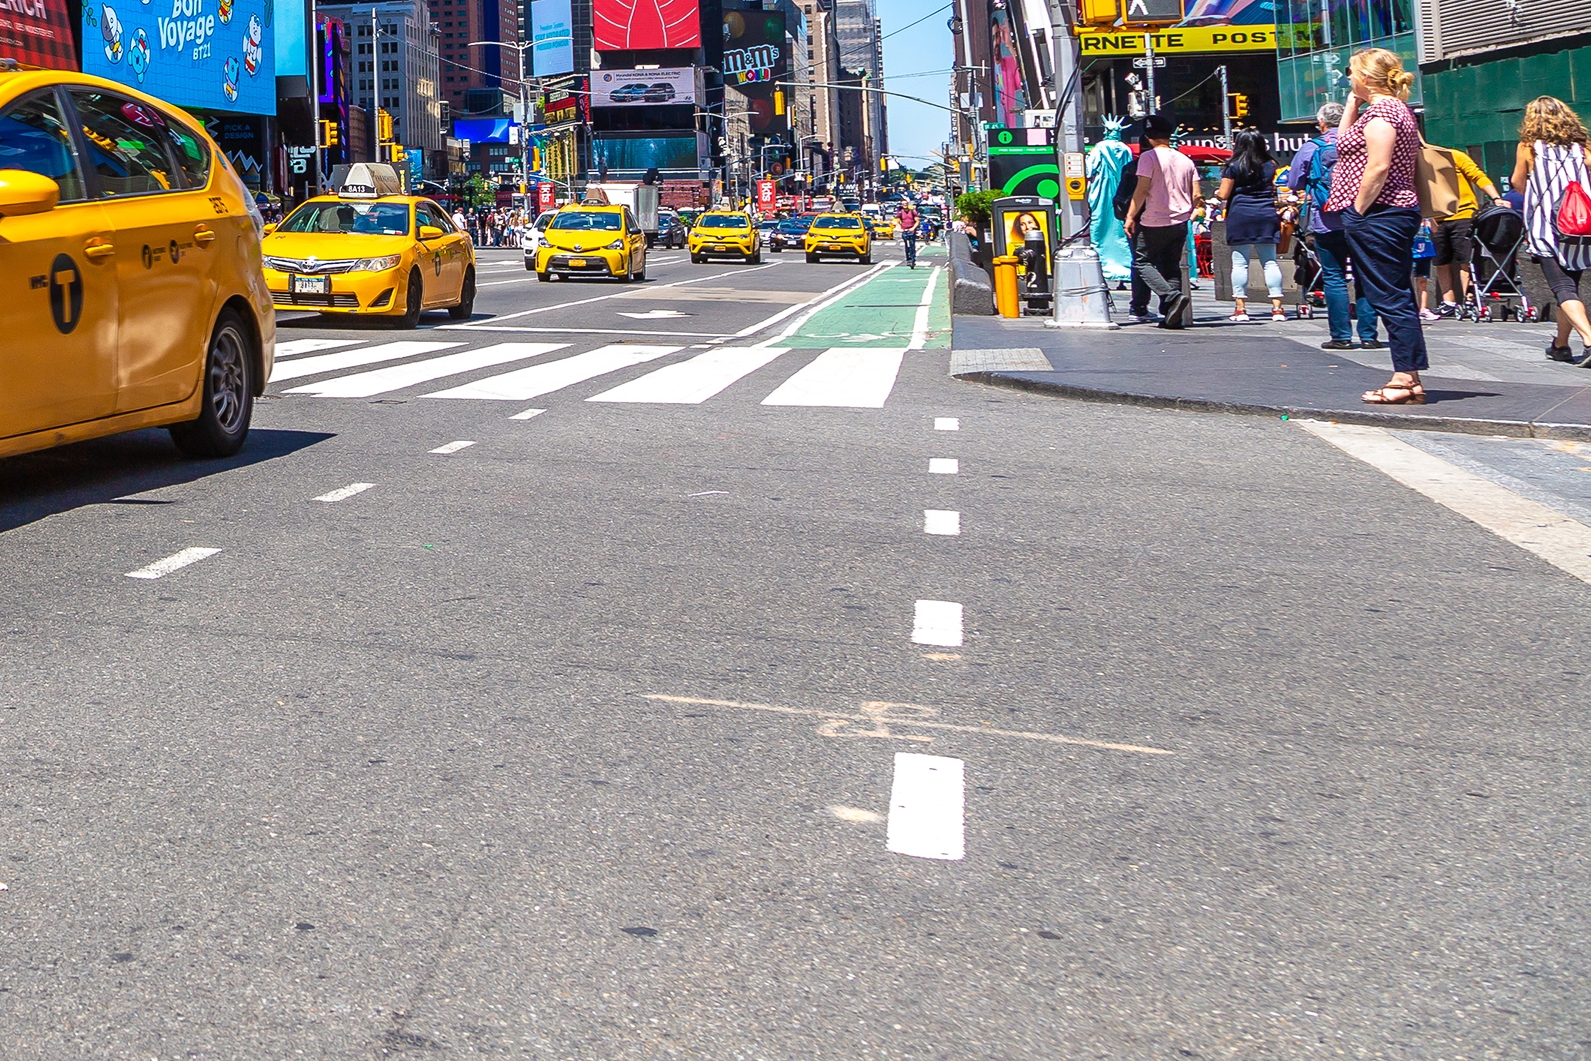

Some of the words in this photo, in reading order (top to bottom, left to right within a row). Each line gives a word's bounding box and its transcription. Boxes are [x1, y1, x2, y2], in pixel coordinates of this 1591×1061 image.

[157, 14, 215, 52] Voyage
[1081, 33, 1184, 50] RNETTE
[192, 40, 211, 61] BT21
[224, 124, 240, 132] PICK
[224, 131, 254, 139] DESIGN
[348, 184, 366, 194] 8A13
[761, 182, 773, 202] tkts
[1027, 271, 1038, 288] 2
